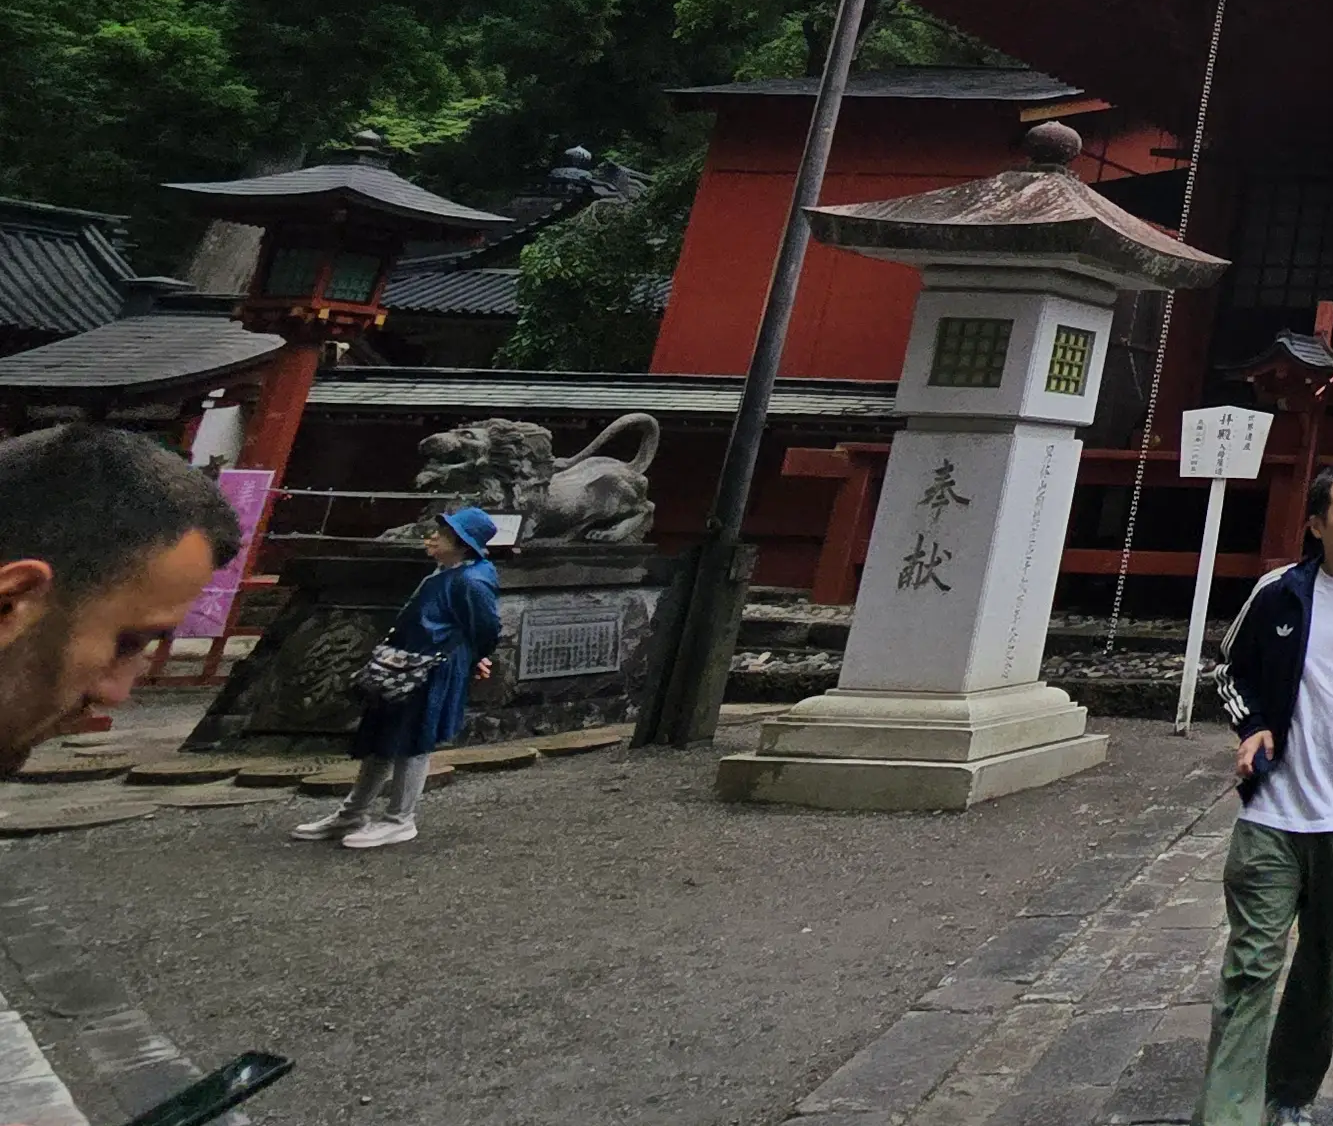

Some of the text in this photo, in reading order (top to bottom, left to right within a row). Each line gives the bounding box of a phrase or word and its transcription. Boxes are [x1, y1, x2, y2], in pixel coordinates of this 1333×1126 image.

[1217, 413, 1234, 441] 拝殿
[1242, 415, 1255, 451] 世界遺産
[898, 459, 971, 592] 奉献
